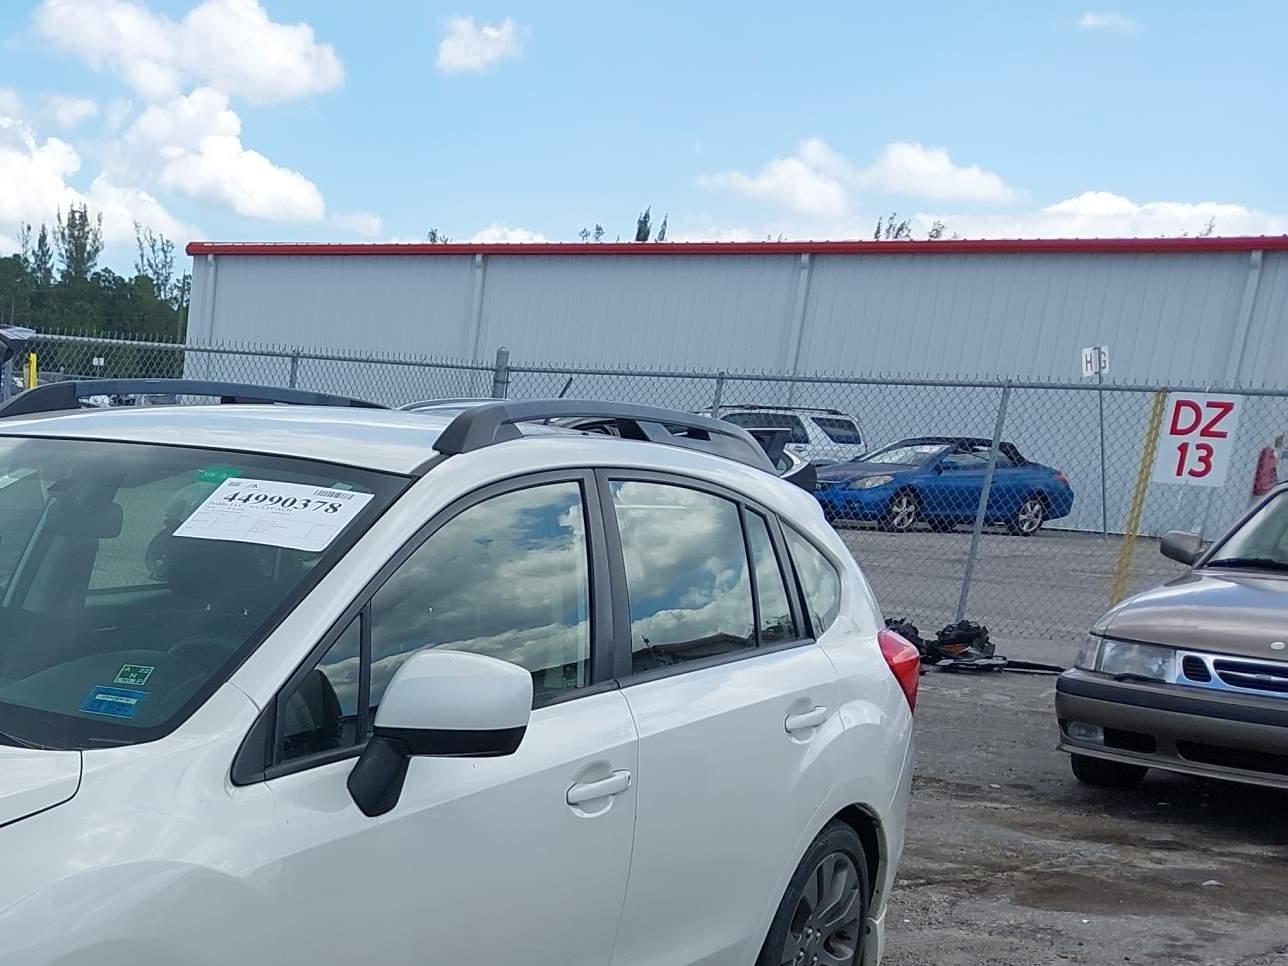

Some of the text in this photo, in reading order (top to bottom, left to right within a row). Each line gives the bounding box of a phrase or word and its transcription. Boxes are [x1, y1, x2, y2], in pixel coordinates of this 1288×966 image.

[1085, 351, 1093, 373] H
[1169, 399, 1235, 439] DZ
[1175, 441, 1215, 479] 13
[223, 491, 343, 514] 44990378
